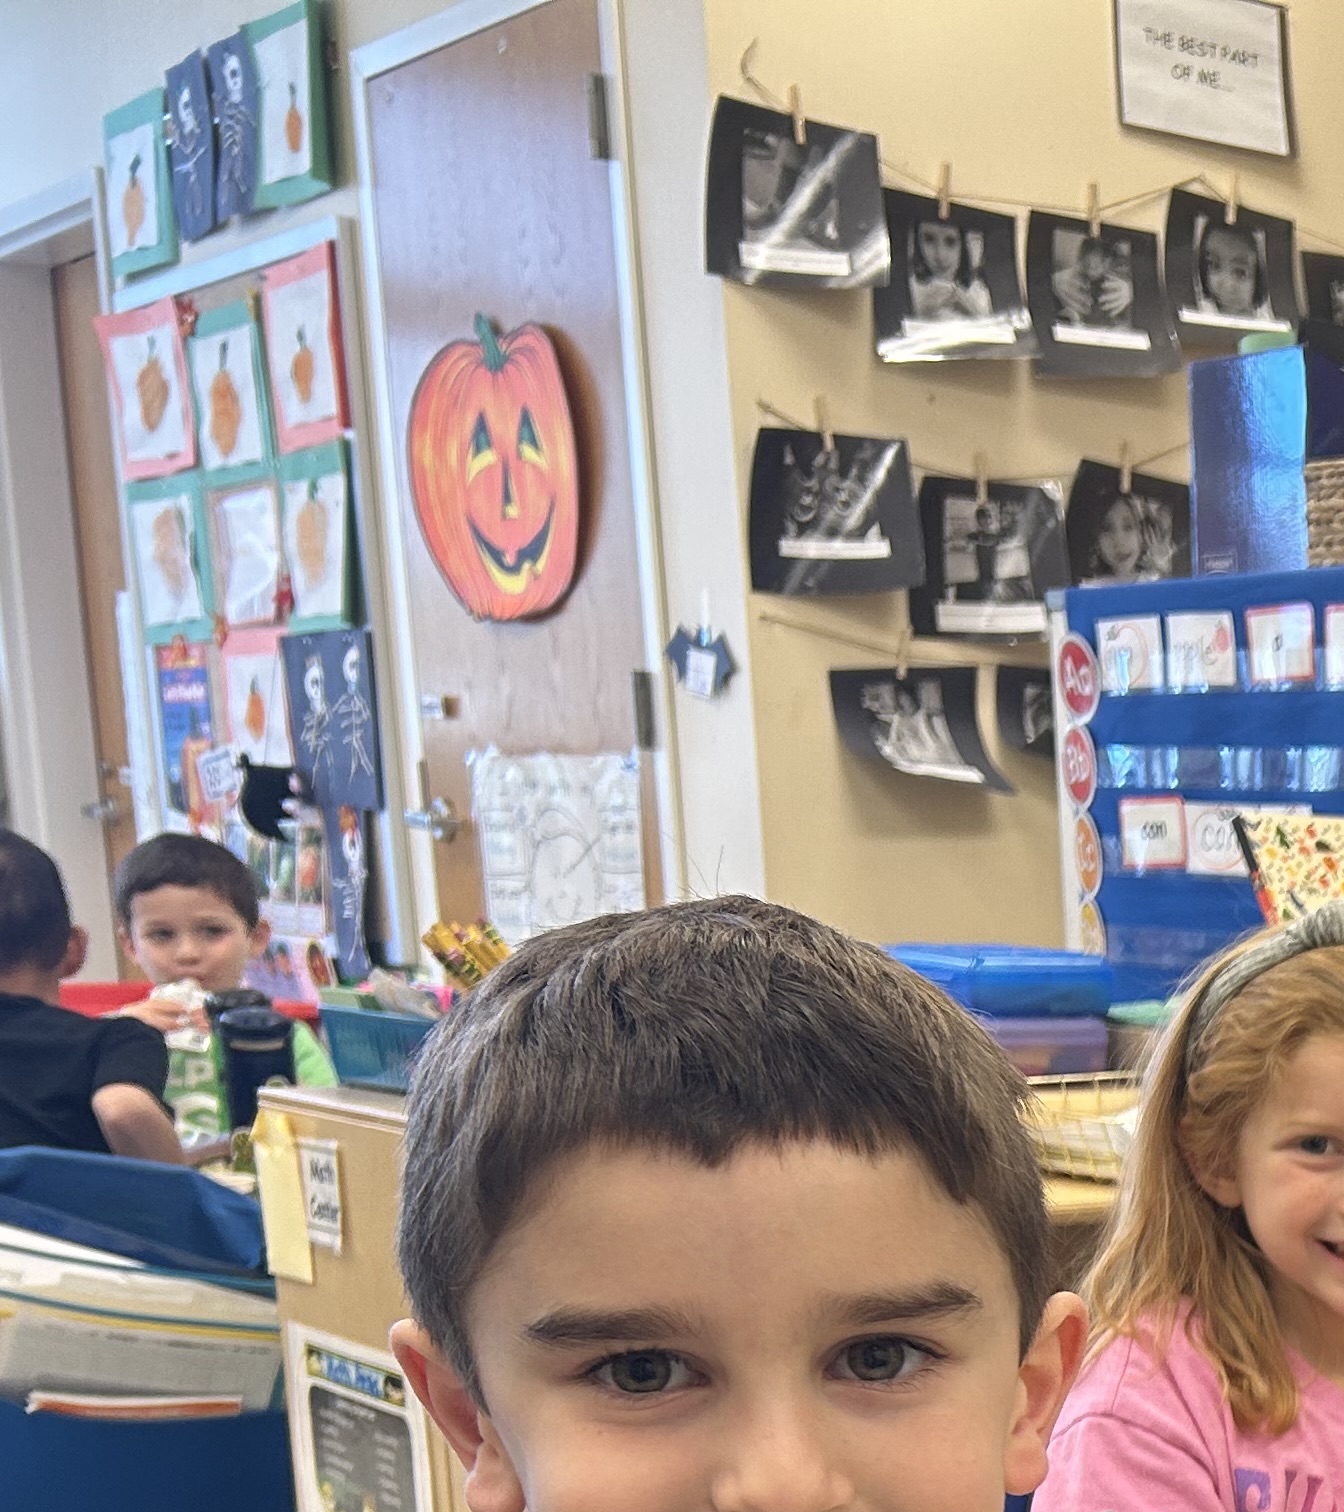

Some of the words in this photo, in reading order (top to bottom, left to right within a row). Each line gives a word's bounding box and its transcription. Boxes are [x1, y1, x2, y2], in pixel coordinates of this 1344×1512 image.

[1142, 27, 1175, 50] THE
[1177, 35, 1217, 58] BEST
[1220, 45, 1259, 68] PART
[1171, 63, 1193, 81] OF
[1064, 664, 1090, 695] Aa
[309, 1157, 335, 1184] Math
